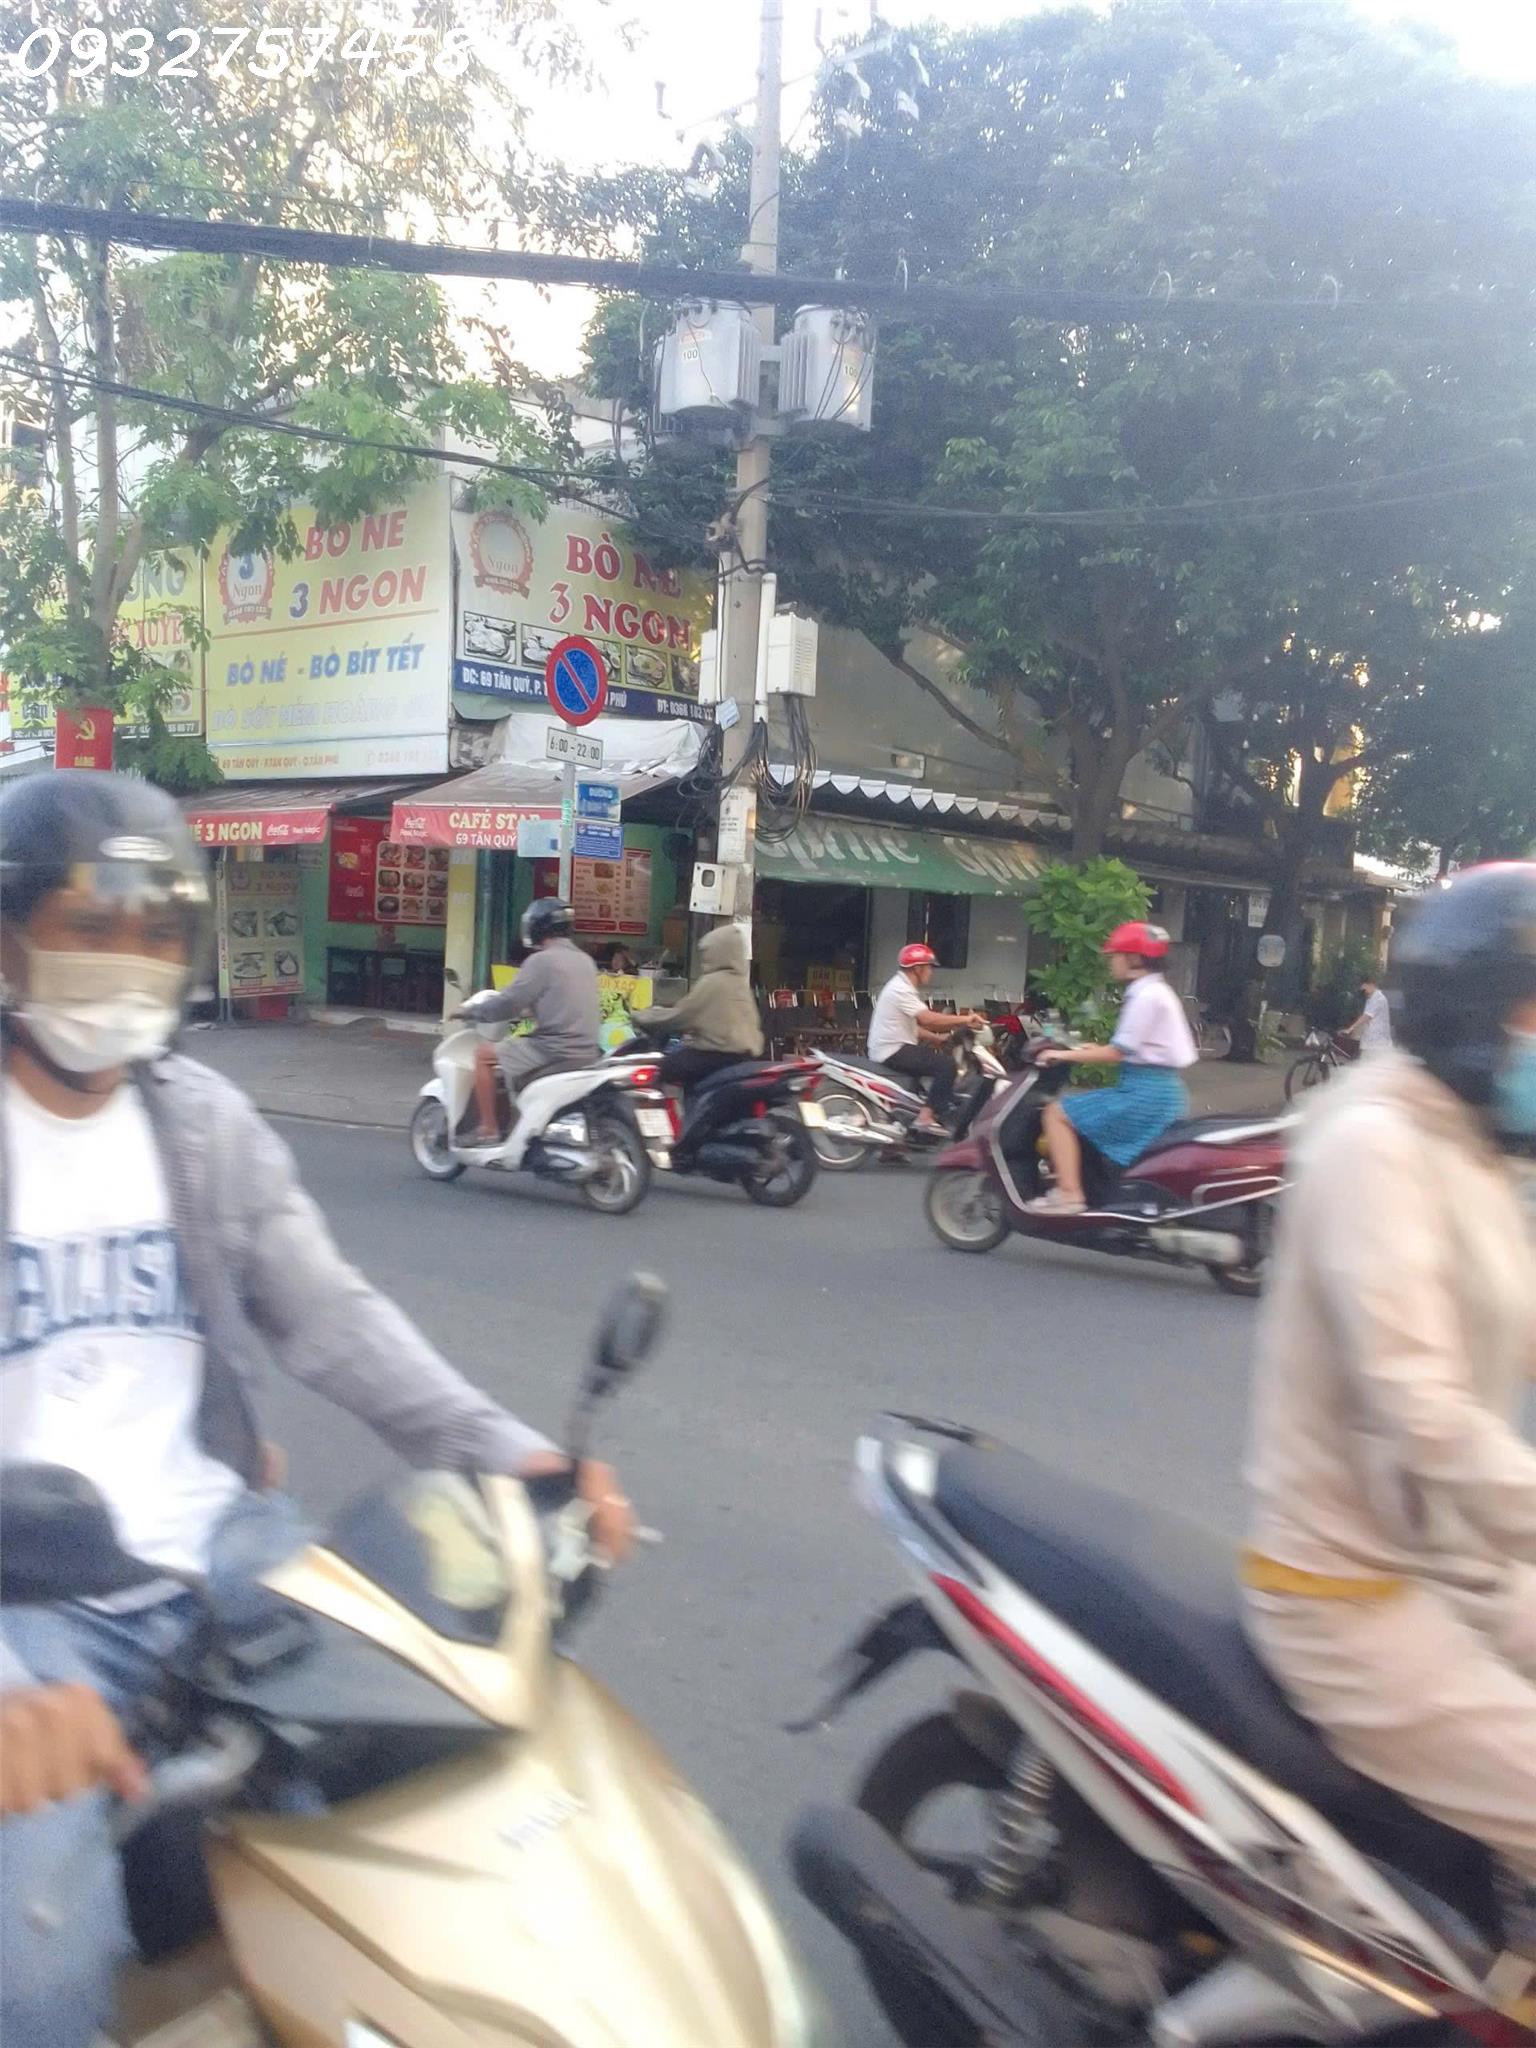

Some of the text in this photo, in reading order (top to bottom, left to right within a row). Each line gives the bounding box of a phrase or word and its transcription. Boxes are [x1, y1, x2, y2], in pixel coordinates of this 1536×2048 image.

[566, 532, 621, 581] BÒ
[232, 582, 263, 600] Ngon
[289, 566, 427, 618] 3 NGON
[548, 582, 692, 651] 3 NGON
[226, 654, 255, 687] BÒ
[259, 651, 288, 684] NÉ
[309, 645, 341, 680] BÒ
[346, 642, 382, 677] BÍT
[386, 633, 426, 672] TẾT
[480, 670, 492, 687] 69
[494, 671, 511, 690] TÂN
[550, 736, 568, 753] 6:00
[449, 809, 492, 829] CAFÉ
[205, 824, 215, 842] 3
[218, 822, 262, 842] NGON
[456, 832, 517, 847] 69 TÂN QUÝ
